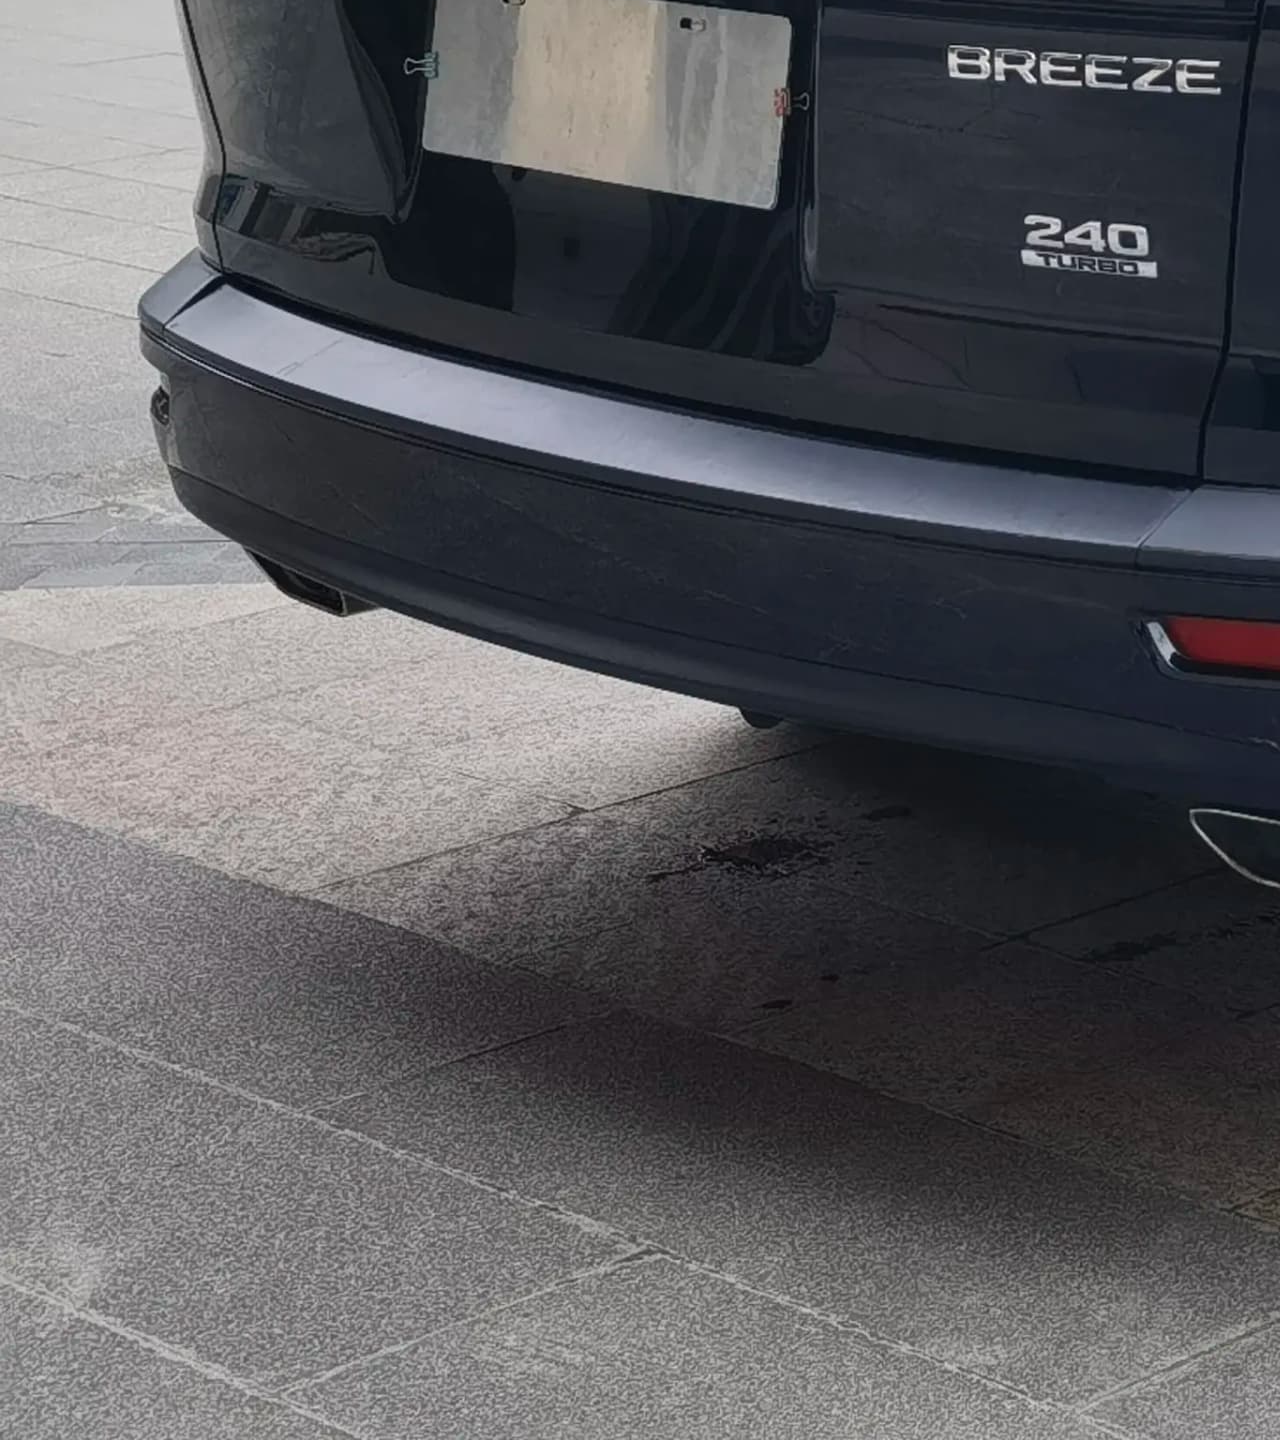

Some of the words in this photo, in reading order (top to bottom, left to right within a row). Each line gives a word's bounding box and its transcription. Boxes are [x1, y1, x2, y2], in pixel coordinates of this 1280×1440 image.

[946, 44, 1222, 95] BREEZE
[1023, 214, 1150, 257] 240
[1034, 253, 1141, 276] TURBO
